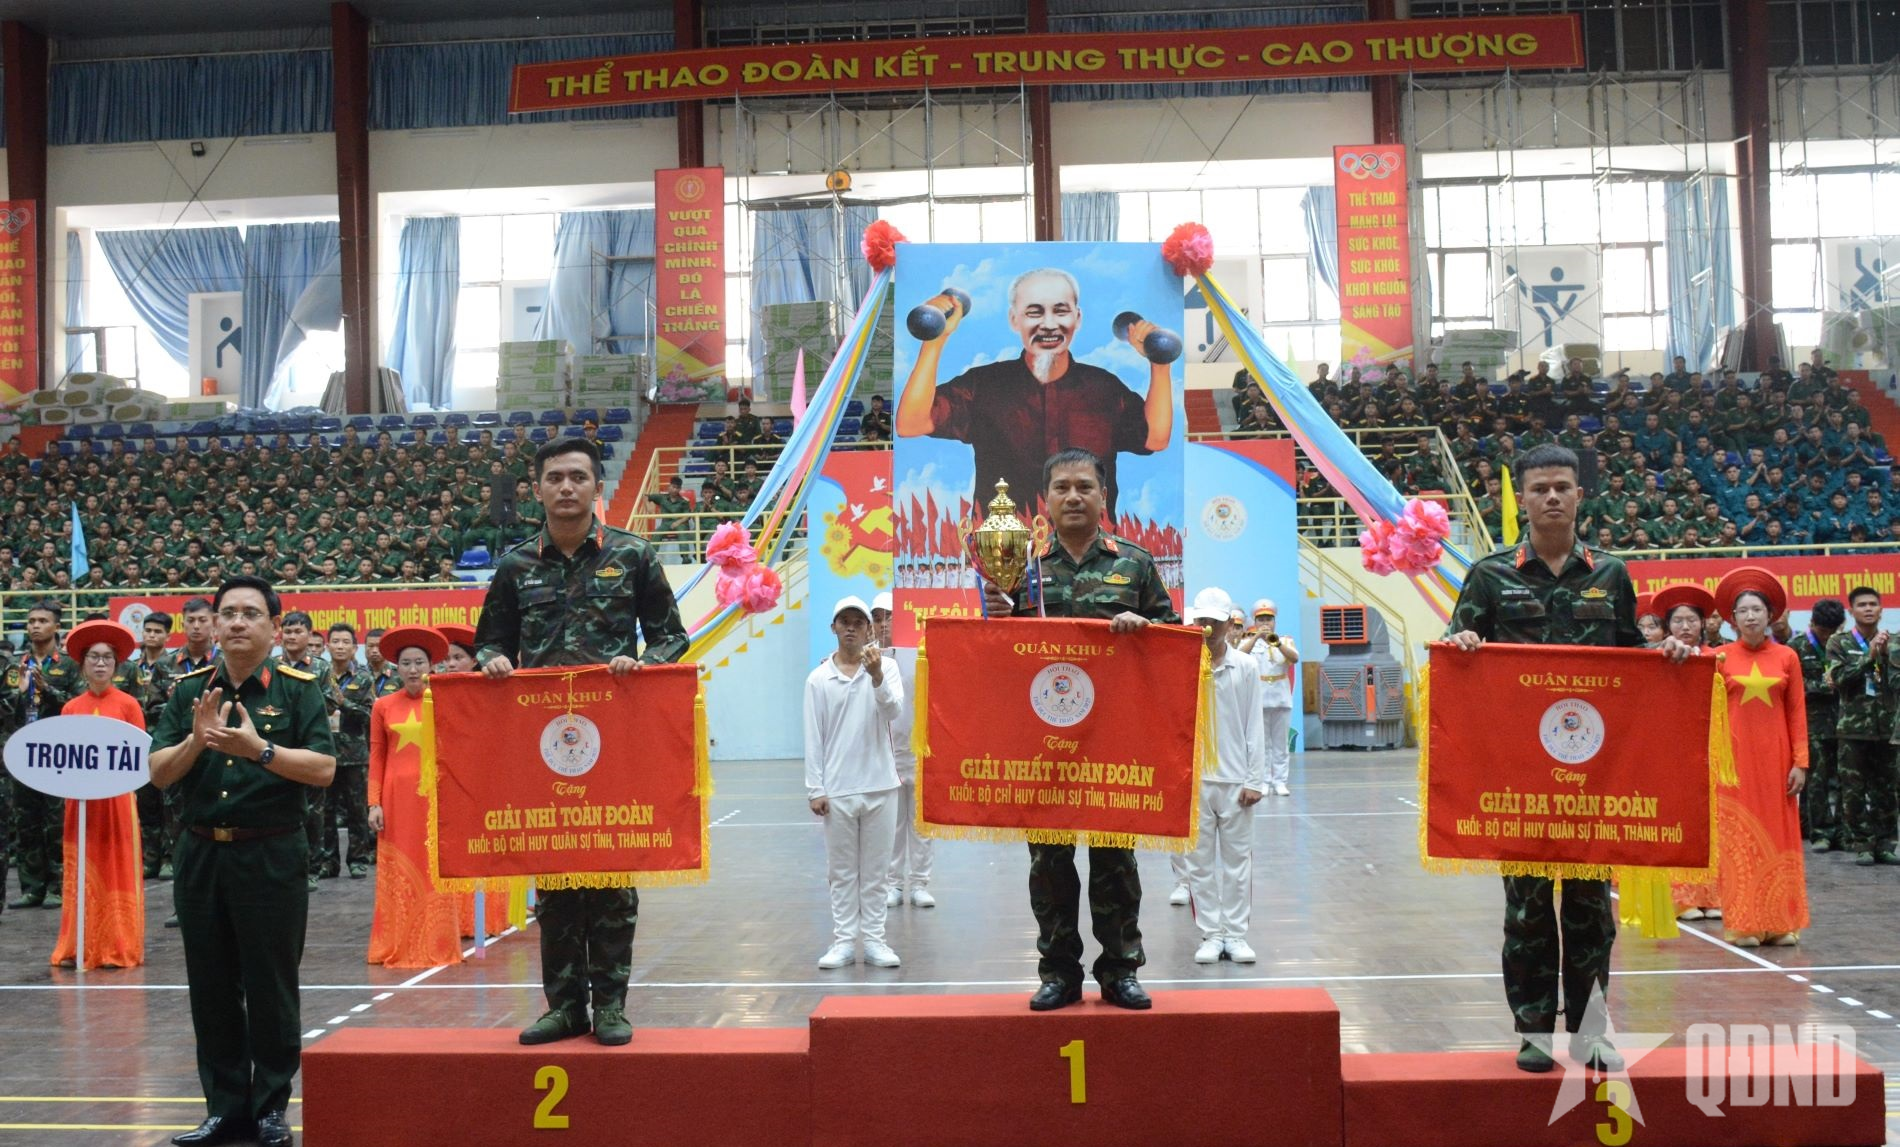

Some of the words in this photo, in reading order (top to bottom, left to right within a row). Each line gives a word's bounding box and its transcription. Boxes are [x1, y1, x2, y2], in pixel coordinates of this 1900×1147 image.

[547, 61, 610, 97] THỂ
[623, 63, 729, 92] THAO
[741, 53, 859, 84] ĐOÀN
[874, 46, 940, 78] KẾT
[972, 48, 1105, 74] TRUNG
[1118, 43, 1225, 76] THỰC
[1260, 39, 1354, 67] CAO
[1364, 32, 1539, 65] THƯỢNG
[1369, 191, 1396, 206] THAO
[668, 209, 713, 222] VƯỢT
[1350, 214, 1379, 229] MANG
[1381, 213, 1397, 230] LẠI
[663, 240, 718, 253] CHÍNH
[1352, 302, 1379, 319] SÁNG
[1792, 569, 1841, 597] GIÀNH
[432, 603, 467, 626] ĐÚNG
[1013, 641, 1062, 657] QUÂN
[1065, 644, 1101, 656] KHU
[1105, 645, 1116, 656] 5
[1518, 671, 1569, 688] QUÂN
[1572, 675, 1609, 688] KHU
[1613, 676, 1622, 688] 5
[516, 691, 562, 707] QUÂN
[567, 690, 602, 704] KHU
[604, 690, 613, 702] 5
[26, 742, 99, 774] TRỌNG
[106, 740, 141, 771] TÀI
[960, 752, 1000, 780] GIẢI
[1003, 752, 1053, 783] NHẤT
[1057, 755, 1105, 785] TOÀN
[1106, 757, 1155, 787] ĐOÀN
[949, 781, 976, 803] KHỐI:
[977, 786, 992, 808] BỘ
[994, 783, 1012, 805] CHỈ
[1014, 788, 1035, 805] HUY
[1038, 786, 1065, 807] QUÂN
[1068, 788, 1083, 809] SỰ
[1108, 787, 1140, 810] THÀNH
[1142, 789, 1164, 812] PHỐ
[1479, 785, 1521, 814] GIẢI
[1524, 794, 1550, 816] BA
[1553, 788, 1600, 817] TOÀN
[1603, 790, 1658, 819] ĐOÀN
[484, 803, 522, 831] GIẢI
[525, 801, 557, 829] NHÌ
[560, 800, 603, 827] TOÀN
[605, 799, 655, 826] ĐOÀN
[1456, 816, 1482, 837] KHỐI:
[1485, 817, 1500, 839] BỘ
[1503, 815, 1521, 838] CHỈ
[1524, 821, 1545, 839] HUY
[1548, 819, 1575, 841] QUÂN
[1577, 820, 1592, 843] SỰ
[1623, 819, 1659, 843] THÀNH
[1661, 821, 1683, 844] PHỐ
[467, 833, 491, 855] KHỐI:
[493, 834, 507, 855] BỘ
[509, 831, 526, 852] CHỈ
[528, 836, 548, 852] HUY
[551, 831, 578, 850] QUÂN
[580, 831, 591, 852] SỰ
[617, 829, 650, 848] THÀNH
[653, 826, 673, 848] PHỐ
[1059, 1039, 1087, 1103] 1
[533, 1065, 570, 1129] 2
[1595, 1080, 1633, 1146] 3
